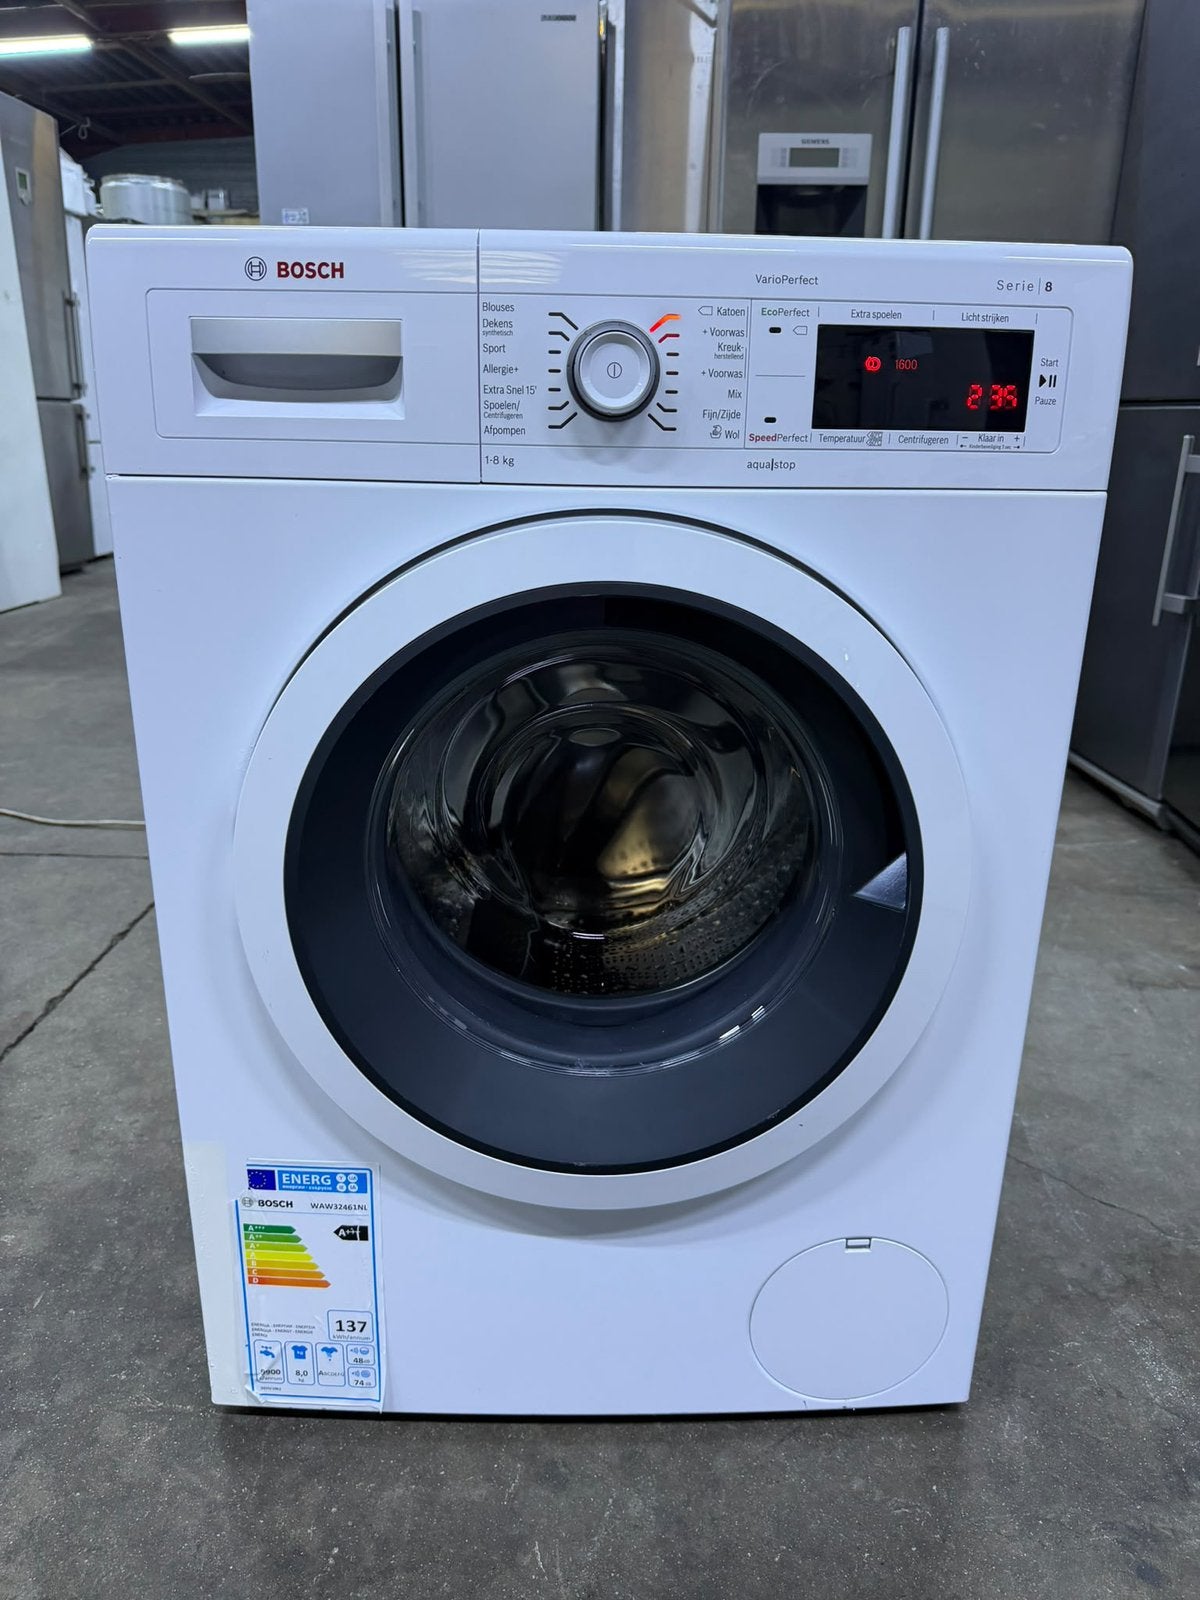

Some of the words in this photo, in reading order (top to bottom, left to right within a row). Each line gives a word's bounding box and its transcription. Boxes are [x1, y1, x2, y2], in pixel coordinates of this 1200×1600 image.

[277, 262, 344, 280] BOSCH
[756, 274, 818, 286] VarioPerfect
[996, 279, 1034, 291] Serie
[1044, 281, 1052, 292] 8
[482, 302, 515, 312] Blouses
[717, 307, 746, 317] Katoen
[761, 308, 810, 317] EcoPerfect
[851, 309, 870, 319] Extra
[872, 310, 902, 321] spoelen
[482, 318, 513, 328] Dekens
[961, 312, 980, 323] Licht
[981, 313, 1009, 324] strijken
[482, 329, 513, 337] synthetisch
[709, 328, 744, 337] Voorwas
[483, 343, 506, 354] Sport
[717, 343, 744, 352] Kreuk-
[895, 359, 918, 370] 1600
[1041, 358, 1058, 367] Start
[483, 364, 519, 375] Allergie+
[708, 368, 743, 378] Voorwas
[483, 385, 504, 394] Extra
[506, 385, 524, 394] Snel
[727, 390, 742, 399] Mix
[484, 400, 520, 411] Spoelen/
[1035, 396, 1056, 406] Pauze
[483, 411, 523, 419] Centrifugeren
[703, 409, 741, 420] Fijn/Zijde
[484, 425, 525, 436] Afpompen
[725, 430, 739, 439] Wol
[749, 433, 808, 443] SpeedPerfect
[819, 434, 866, 445] Temperatuur
[898, 434, 949, 446] Centrifugeren
[978, 434, 996, 442] Klaar
[998, 434, 1004, 442] in
[485, 456, 499, 464] 1-8
[503, 456, 514, 466] kg
[282, 1174, 331, 1185] ENERG
[258, 1200, 293, 1208] BOSCH
[311, 1203, 368, 1211] WAW32461NL
[336, 1320, 367, 1333] 137
